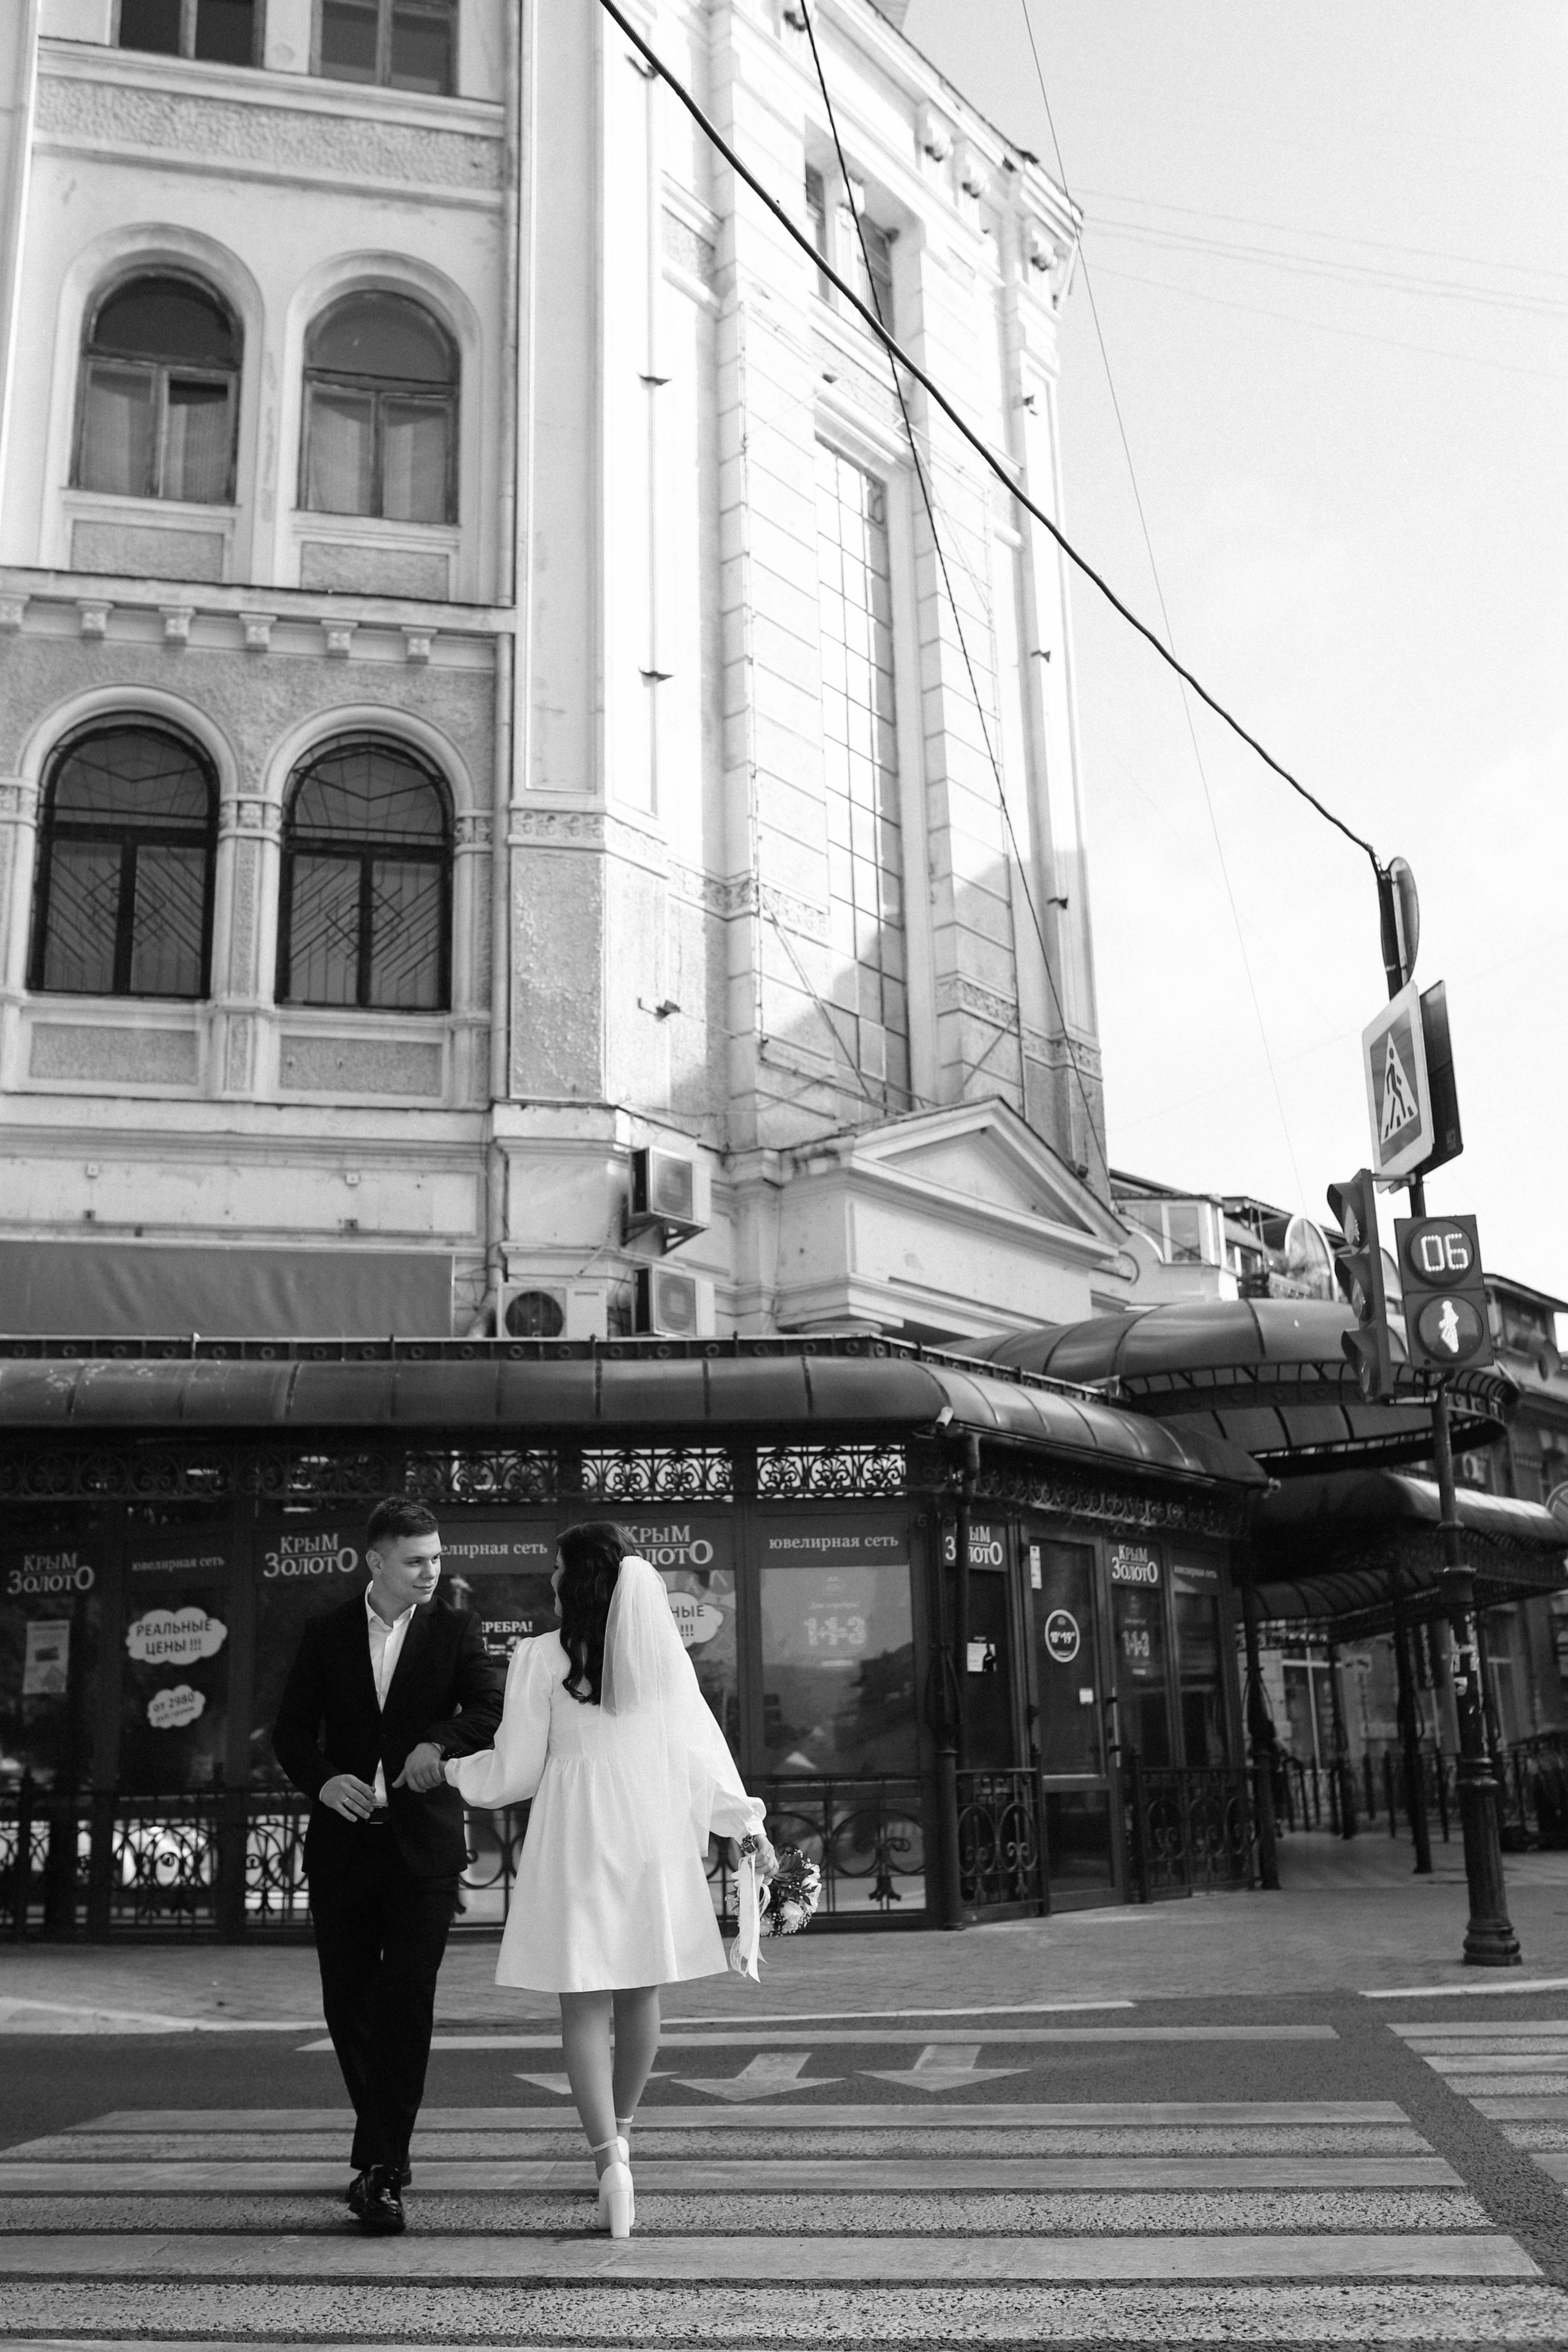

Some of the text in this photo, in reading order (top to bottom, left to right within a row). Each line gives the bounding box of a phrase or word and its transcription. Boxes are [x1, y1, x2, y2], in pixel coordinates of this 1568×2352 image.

[1420, 1232, 1469, 1272] 06
[969, 1525, 990, 1543] ЫМ
[281, 1533, 338, 1554] КРЫМ
[440, 1544, 548, 1558] елирная сеть
[635, 1539, 714, 1565] ЛОТО
[769, 1536, 899, 1551] ювелирная сеть
[945, 1536, 1003, 1566] ЗОТО
[23, 1551, 77, 1572] КРЫМ
[1118, 1544, 1148, 1562] КРЫМ
[136, 1618, 212, 1637] РЕАЛЬНЫЕ
[481, 1621, 533, 1633] РЕБРА!
[145, 1638, 186, 1656] ЦЕНЫ
